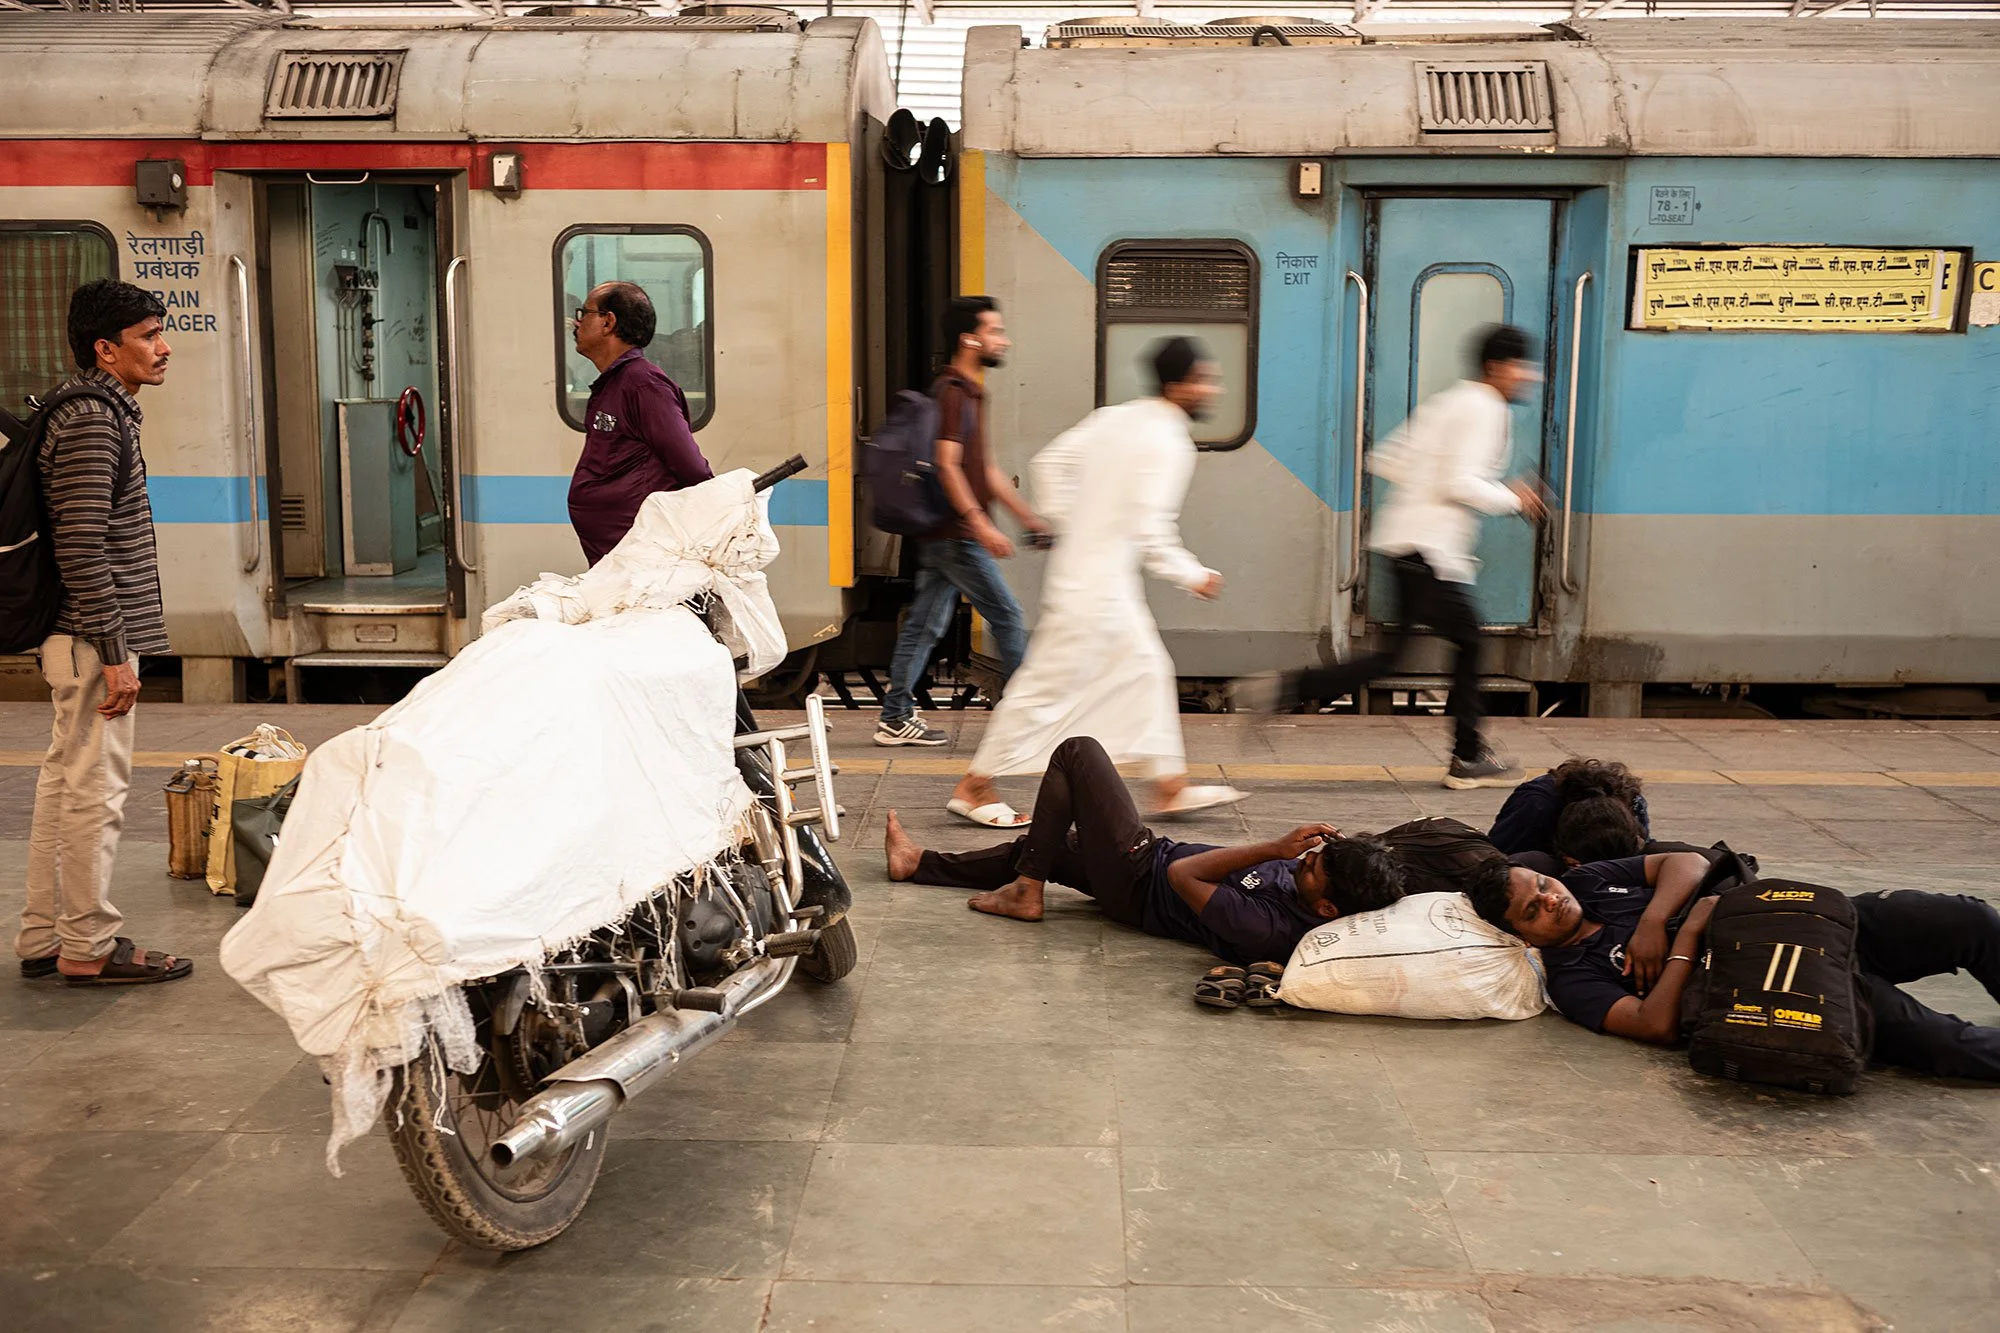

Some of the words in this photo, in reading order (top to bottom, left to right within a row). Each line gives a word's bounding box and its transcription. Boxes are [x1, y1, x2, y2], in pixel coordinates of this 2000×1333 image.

[1657, 200, 1671, 211] 78
[1682, 201, 1688, 212] 1
[126, 230, 205, 258] रेलगाड़ी
[134, 256, 200, 279] प्रबंधक
[1275, 251, 1319, 269] निकास
[1651, 257, 1666, 279] पुणे
[1782, 256, 1798, 277] धुले
[1915, 254, 1930, 276] पुणे
[1284, 272, 1311, 285] EXIT
[151, 290, 200, 308] RAIN
[1650, 294, 1665, 316] पुणे
[1778, 292, 1794, 313] धुले
[1911, 290, 1926, 312] पुणे
[162, 314, 217, 332] AGER
